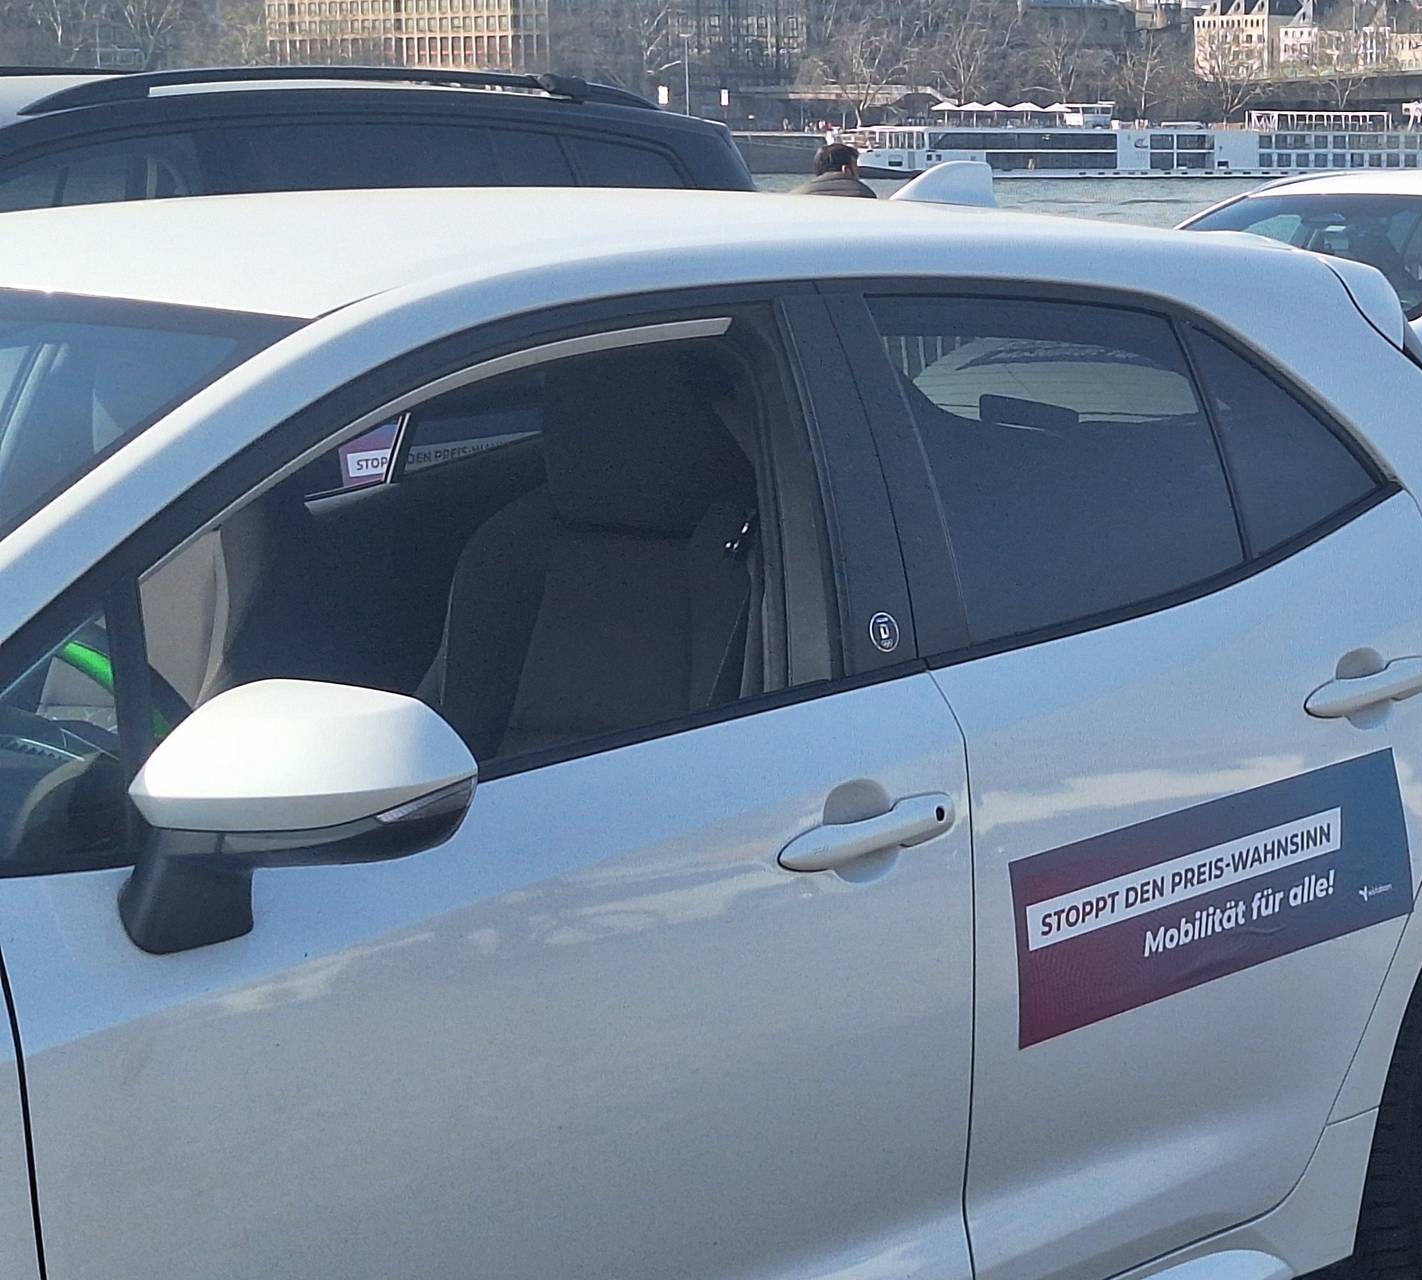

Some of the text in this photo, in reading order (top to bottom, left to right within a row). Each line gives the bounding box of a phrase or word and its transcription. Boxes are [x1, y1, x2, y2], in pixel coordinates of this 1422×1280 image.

[356, 456, 388, 471] STOP
[1041, 823, 1331, 936] STOPPT DEN PREIS-WAHNSINN
[1144, 869, 1336, 957] Mobilität für alle!
